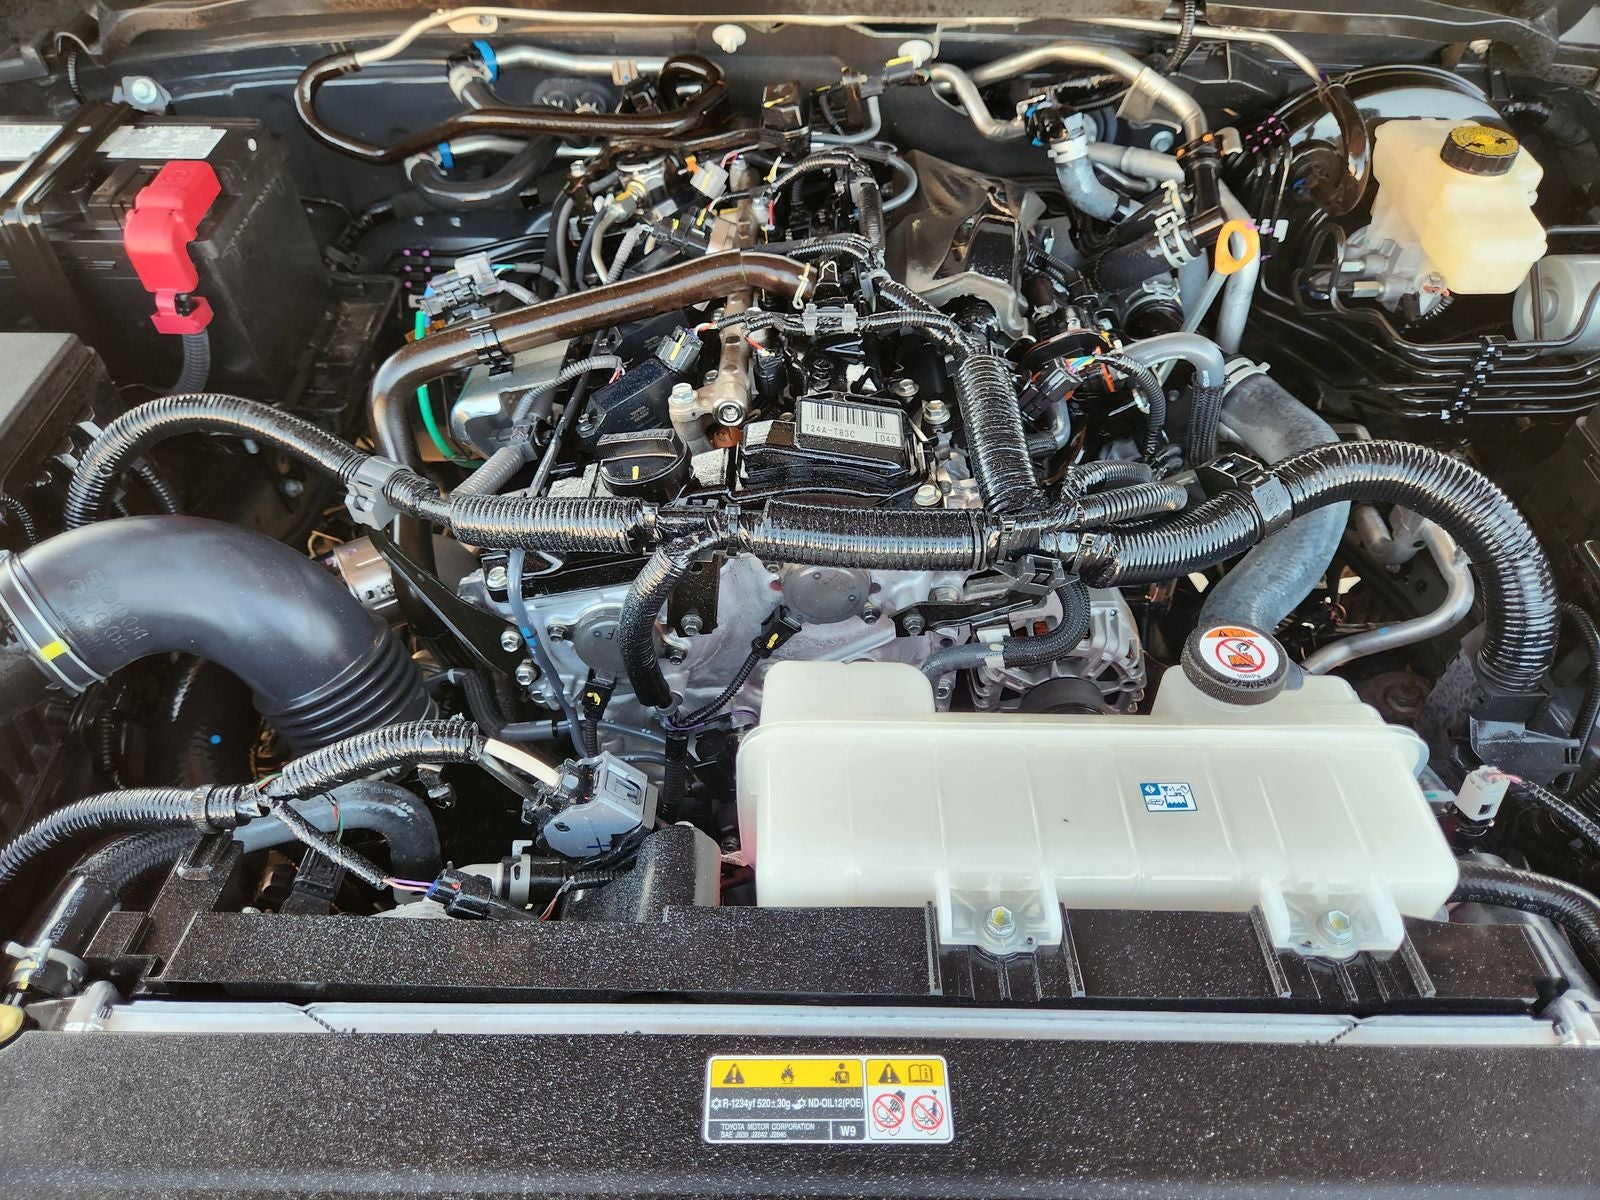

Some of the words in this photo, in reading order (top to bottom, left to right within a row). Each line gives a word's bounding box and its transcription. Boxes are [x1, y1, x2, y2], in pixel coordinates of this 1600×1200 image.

[805, 424, 856, 439] T24A-T83C
[881, 435, 897, 444] 040
[722, 1098, 756, 1110] R-1234yf
[757, 1098, 791, 1110] 520±30g
[808, 1097, 864, 1110] ND-OIL12(POE)
[721, 1122, 745, 1130] TOYOTA
[747, 1122, 770, 1130] MOTOR
[771, 1122, 816, 1130] CORPORATION
[840, 1125, 857, 1137] W9
